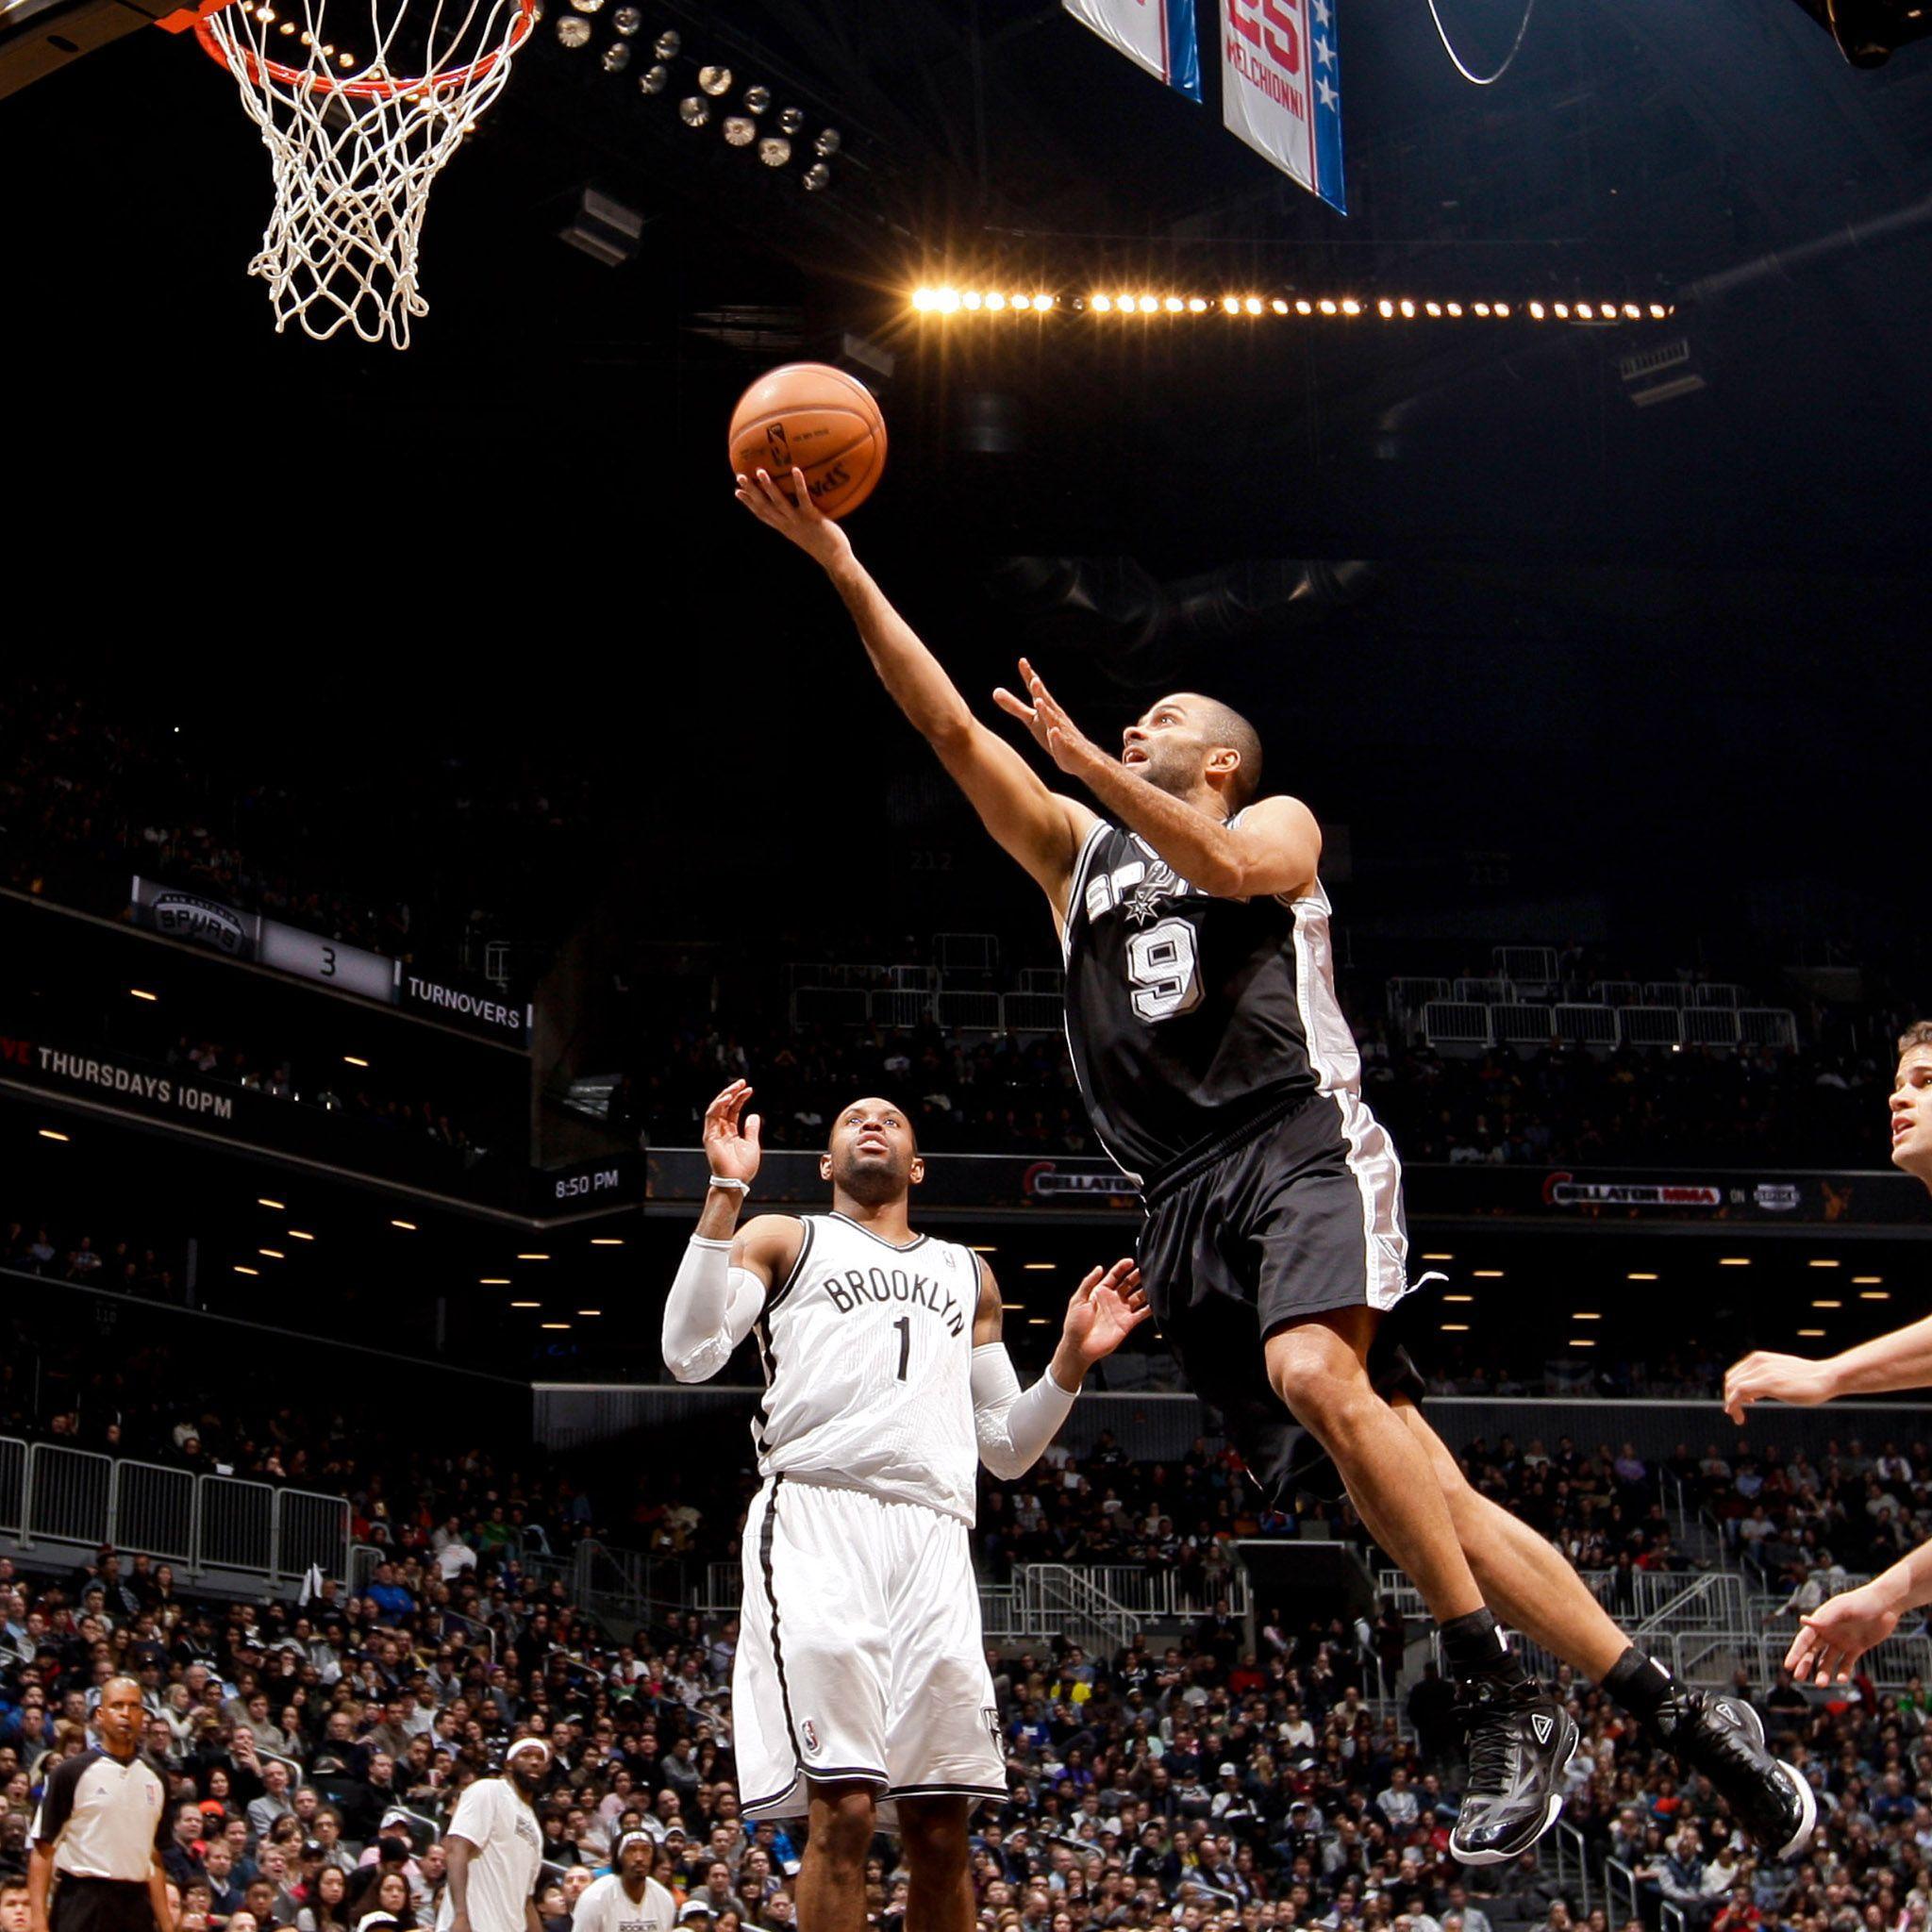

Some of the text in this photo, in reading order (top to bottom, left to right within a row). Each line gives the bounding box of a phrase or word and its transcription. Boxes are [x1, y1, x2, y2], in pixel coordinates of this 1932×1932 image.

[1226, 36, 1304, 122] MELCHIONNI
[160, 909, 236, 947] SPURS
[321, 947, 336, 976] 3
[1126, 917, 1206, 1023] 9
[408, 976, 520, 1029] TURNOVERS
[39, 1047, 171, 1103] THURSDAYS
[178, 1087, 232, 1120] 10PM
[556, 1169, 619, 1198] 8:50 PM
[823, 1267, 964, 1338] BROOKLYN
[893, 1316, 910, 1381] 1
